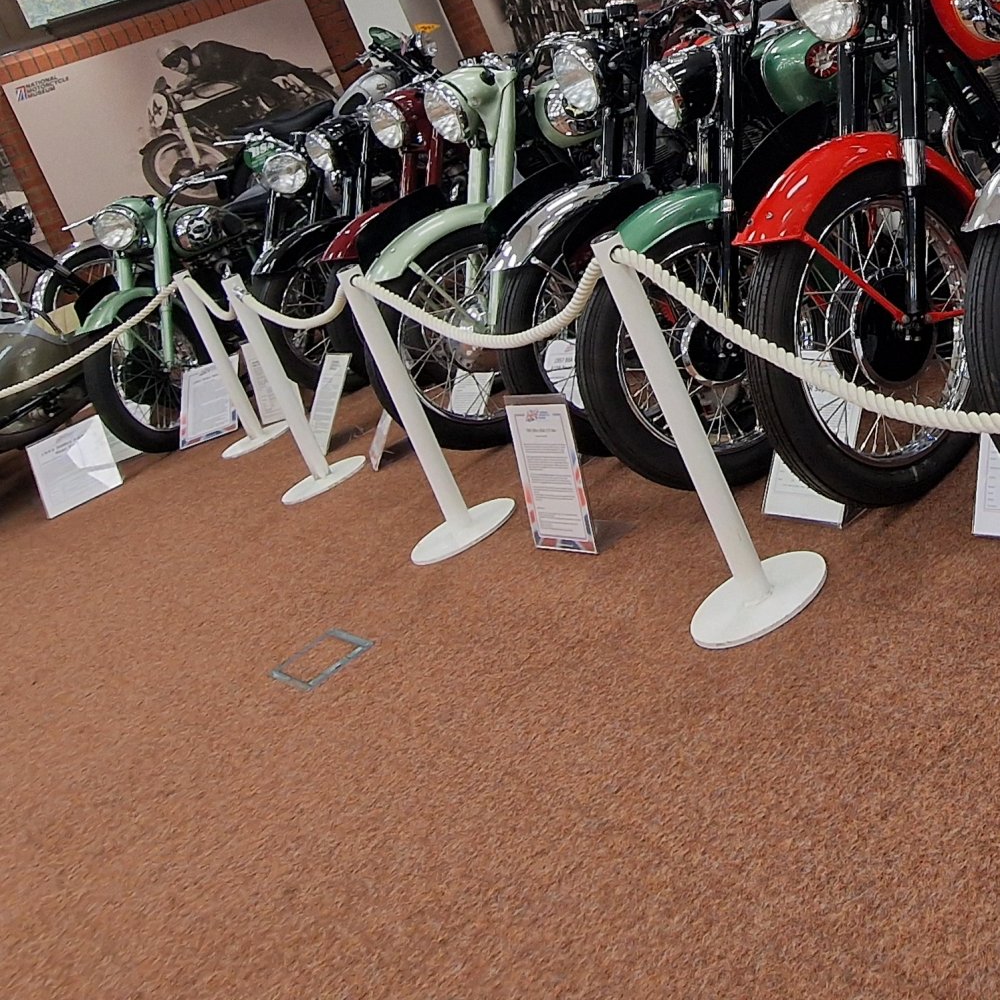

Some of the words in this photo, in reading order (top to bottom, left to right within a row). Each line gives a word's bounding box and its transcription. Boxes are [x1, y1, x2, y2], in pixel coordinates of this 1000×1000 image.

[25, 75, 58, 87] NATIONAL
[26, 76, 69, 93] MOTORCYCLE
[27, 86, 56, 98] MUSEUM
